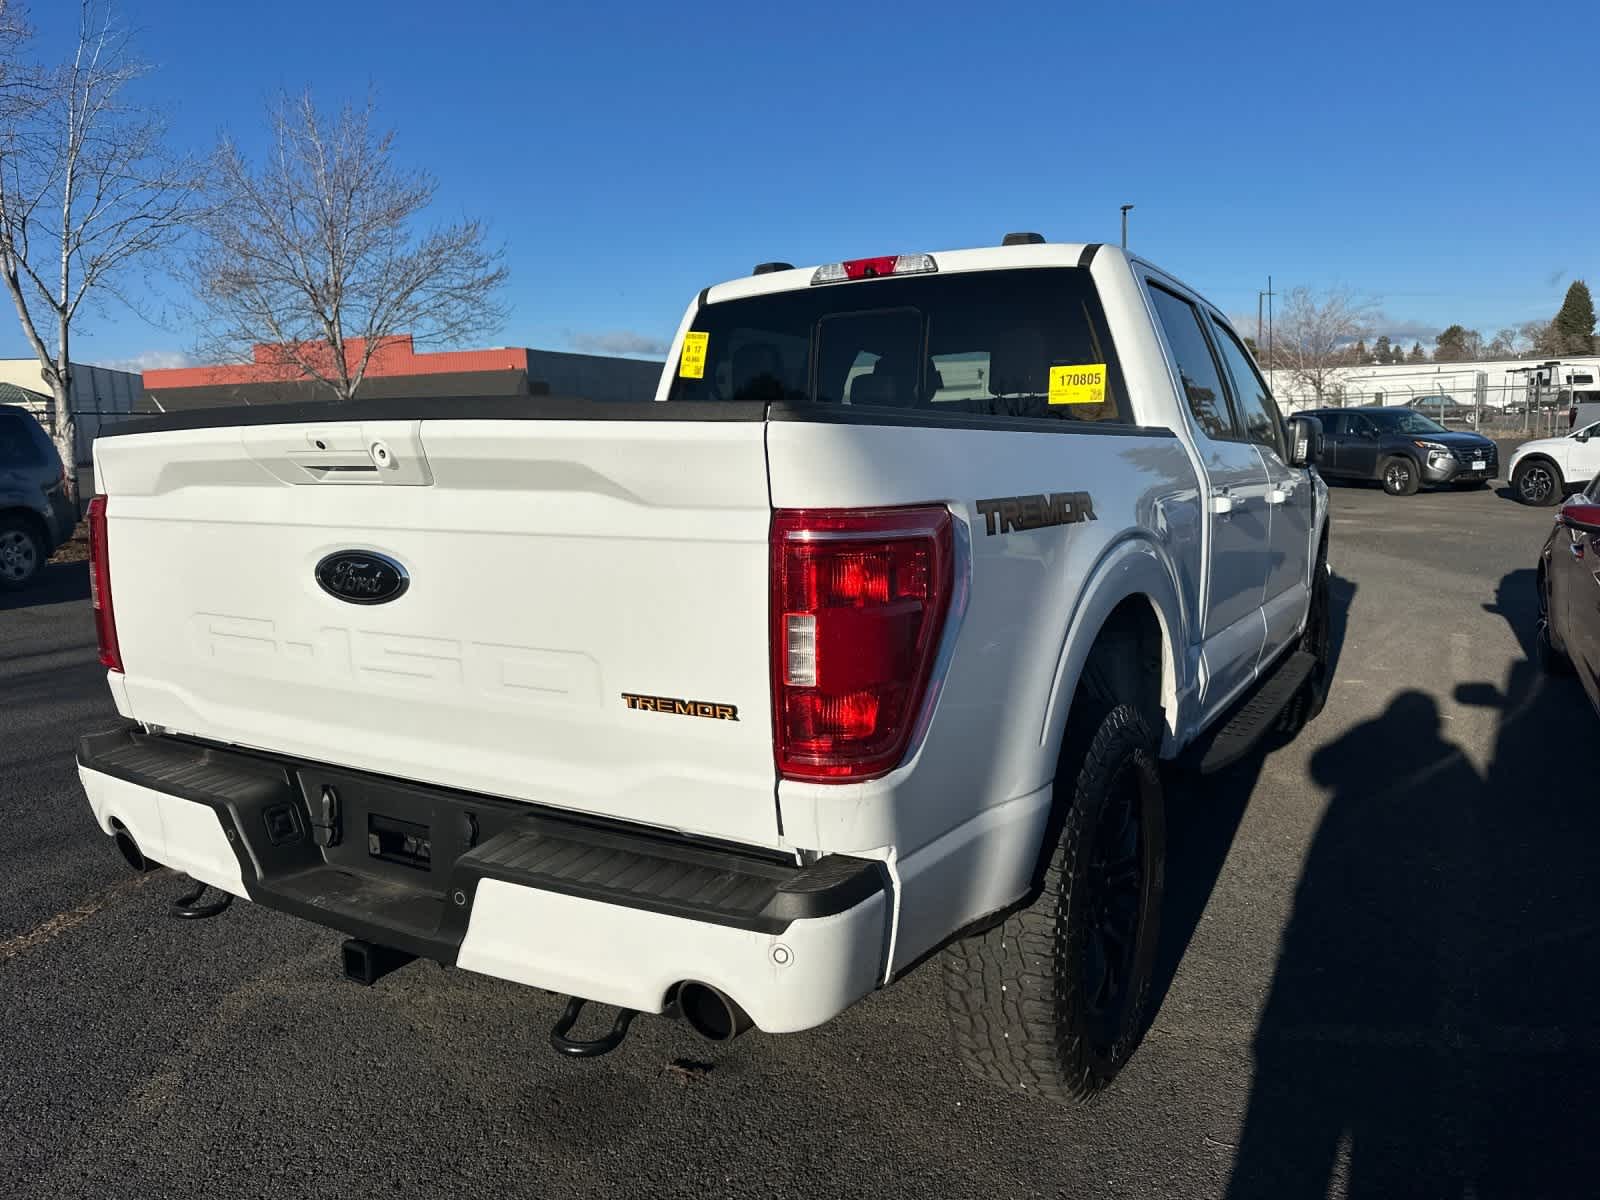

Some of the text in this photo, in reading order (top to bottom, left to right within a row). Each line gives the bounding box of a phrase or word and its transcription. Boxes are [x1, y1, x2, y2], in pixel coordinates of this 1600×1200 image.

[1059, 372, 1101, 386] 170805
[975, 491, 1098, 536] TREMOR
[331, 560, 382, 592] Ford
[187, 611, 603, 709] F-150
[621, 692, 741, 721] TREMOR
